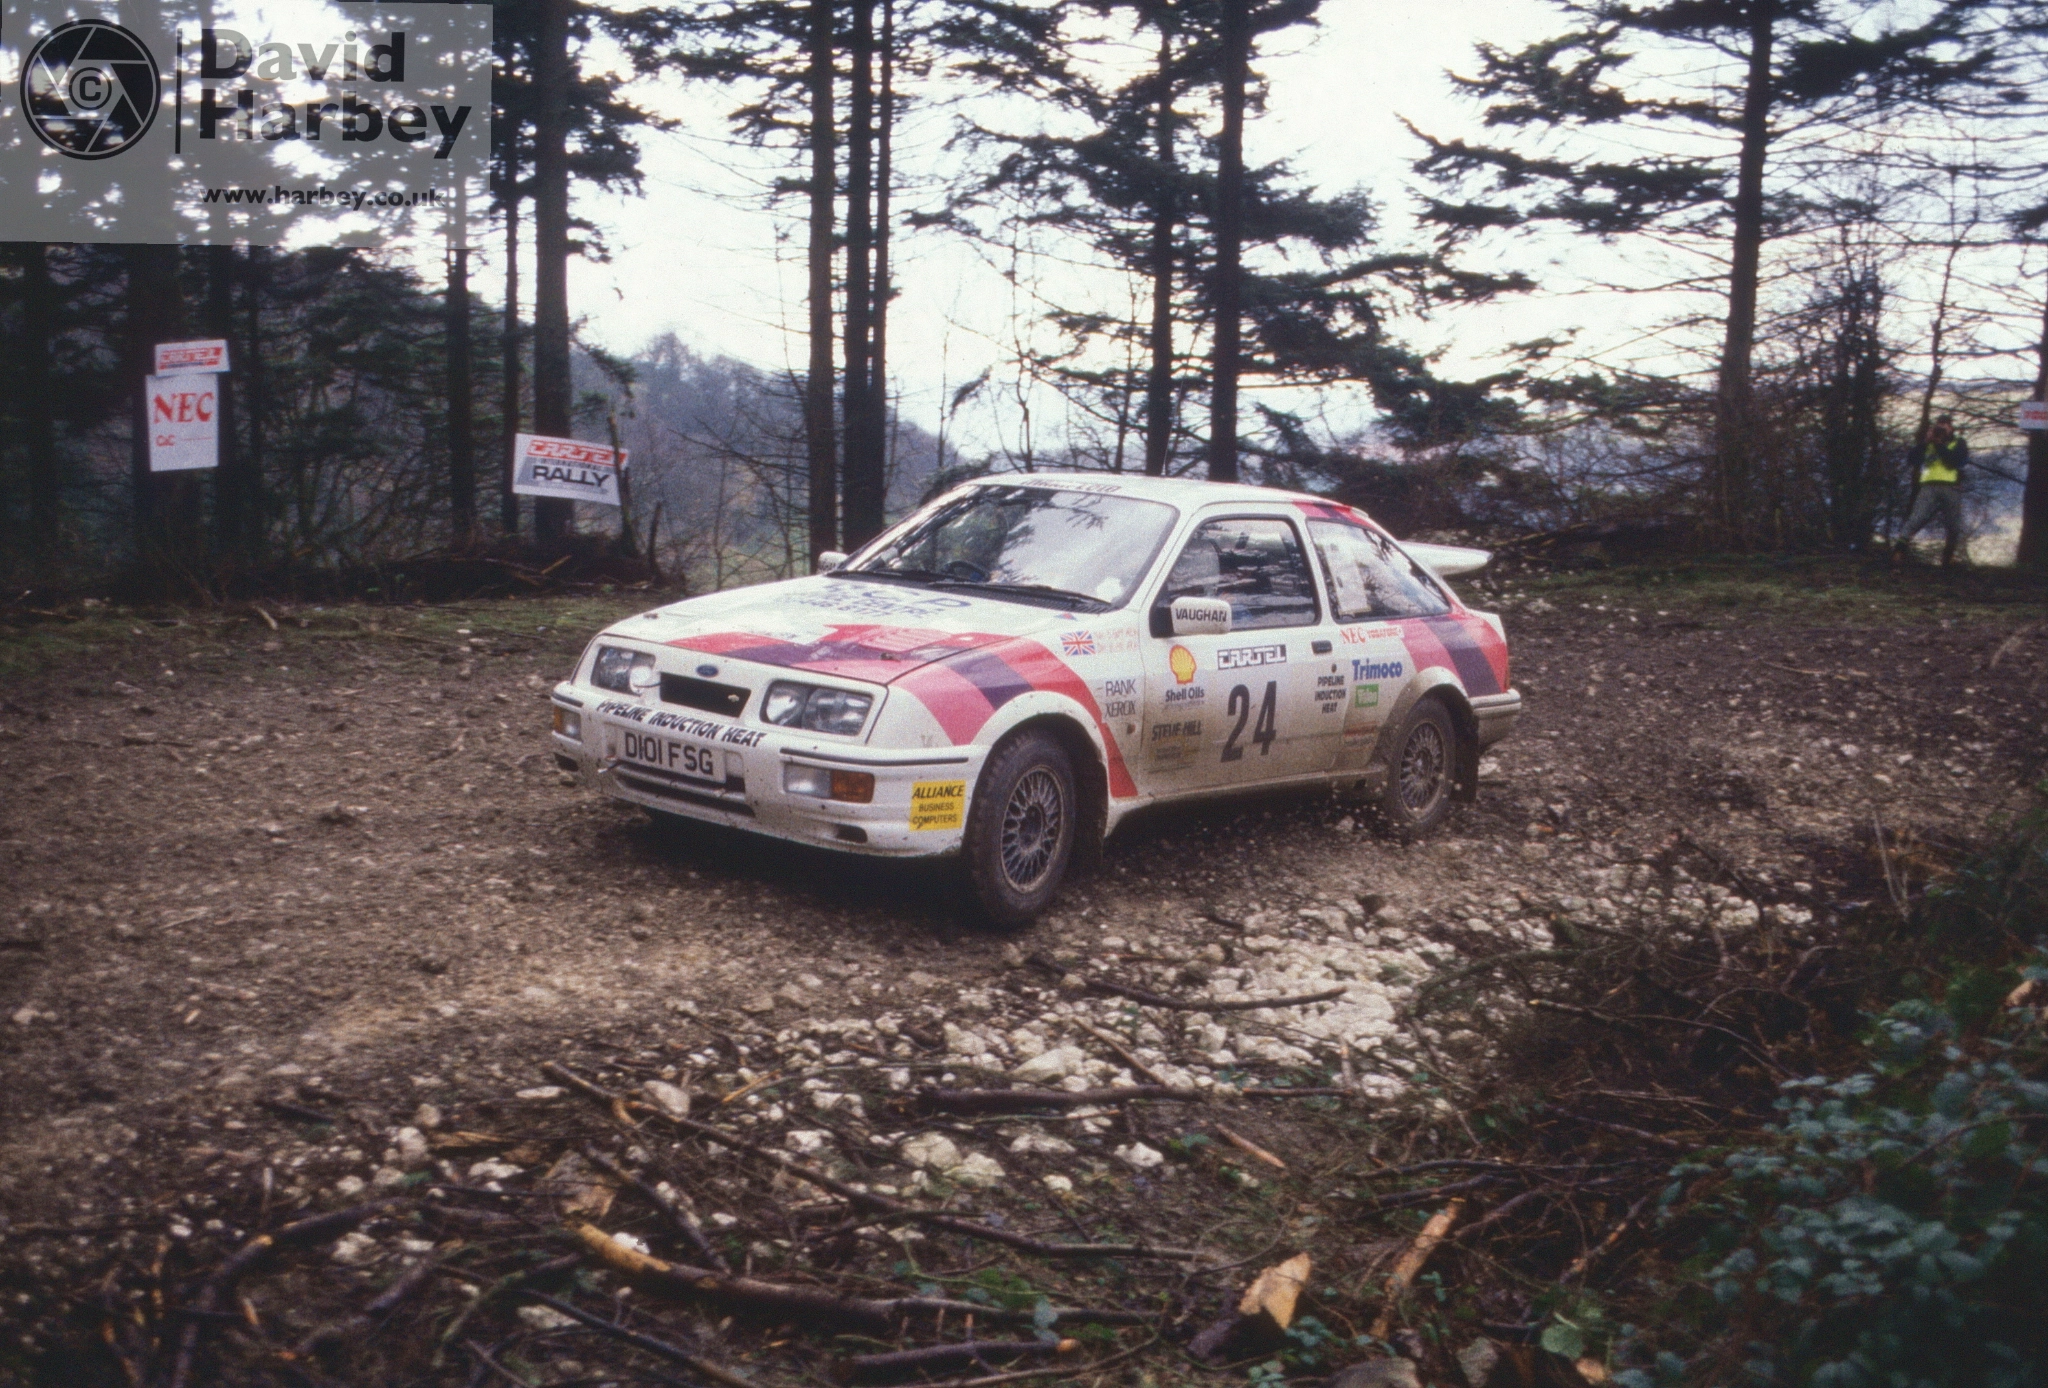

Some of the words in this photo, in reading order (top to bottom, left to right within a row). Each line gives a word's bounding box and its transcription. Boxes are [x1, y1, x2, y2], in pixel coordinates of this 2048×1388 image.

[153, 392, 214, 424] NEC
[532, 465, 609, 487] RALLY
[1175, 609, 1227, 622] VAUGHAN
[1340, 627, 1366, 644] NEC
[1218, 645, 1286, 670] CARTEL
[1351, 658, 1403, 681] Trimoco
[1105, 679, 1137, 697] RANK
[1318, 675, 1345, 687] PIPELINE
[1165, 688, 1187, 703] Shell
[1187, 687, 1205, 700] Oils
[1314, 688, 1347, 702] INDUCTION
[1104, 701, 1137, 719] XEROX
[1322, 702, 1338, 714] HEAT
[596, 701, 651, 722] PIPELINE
[649, 711, 723, 740] INDUCTION
[721, 727, 767, 748] HEAT
[1220, 680, 1277, 763] 24
[668, 746, 714, 776] FSG
[912, 785, 964, 799] ALLIANCE
[918, 802, 955, 813] BUSINESS
[912, 814, 957, 829] COMPUTERS
